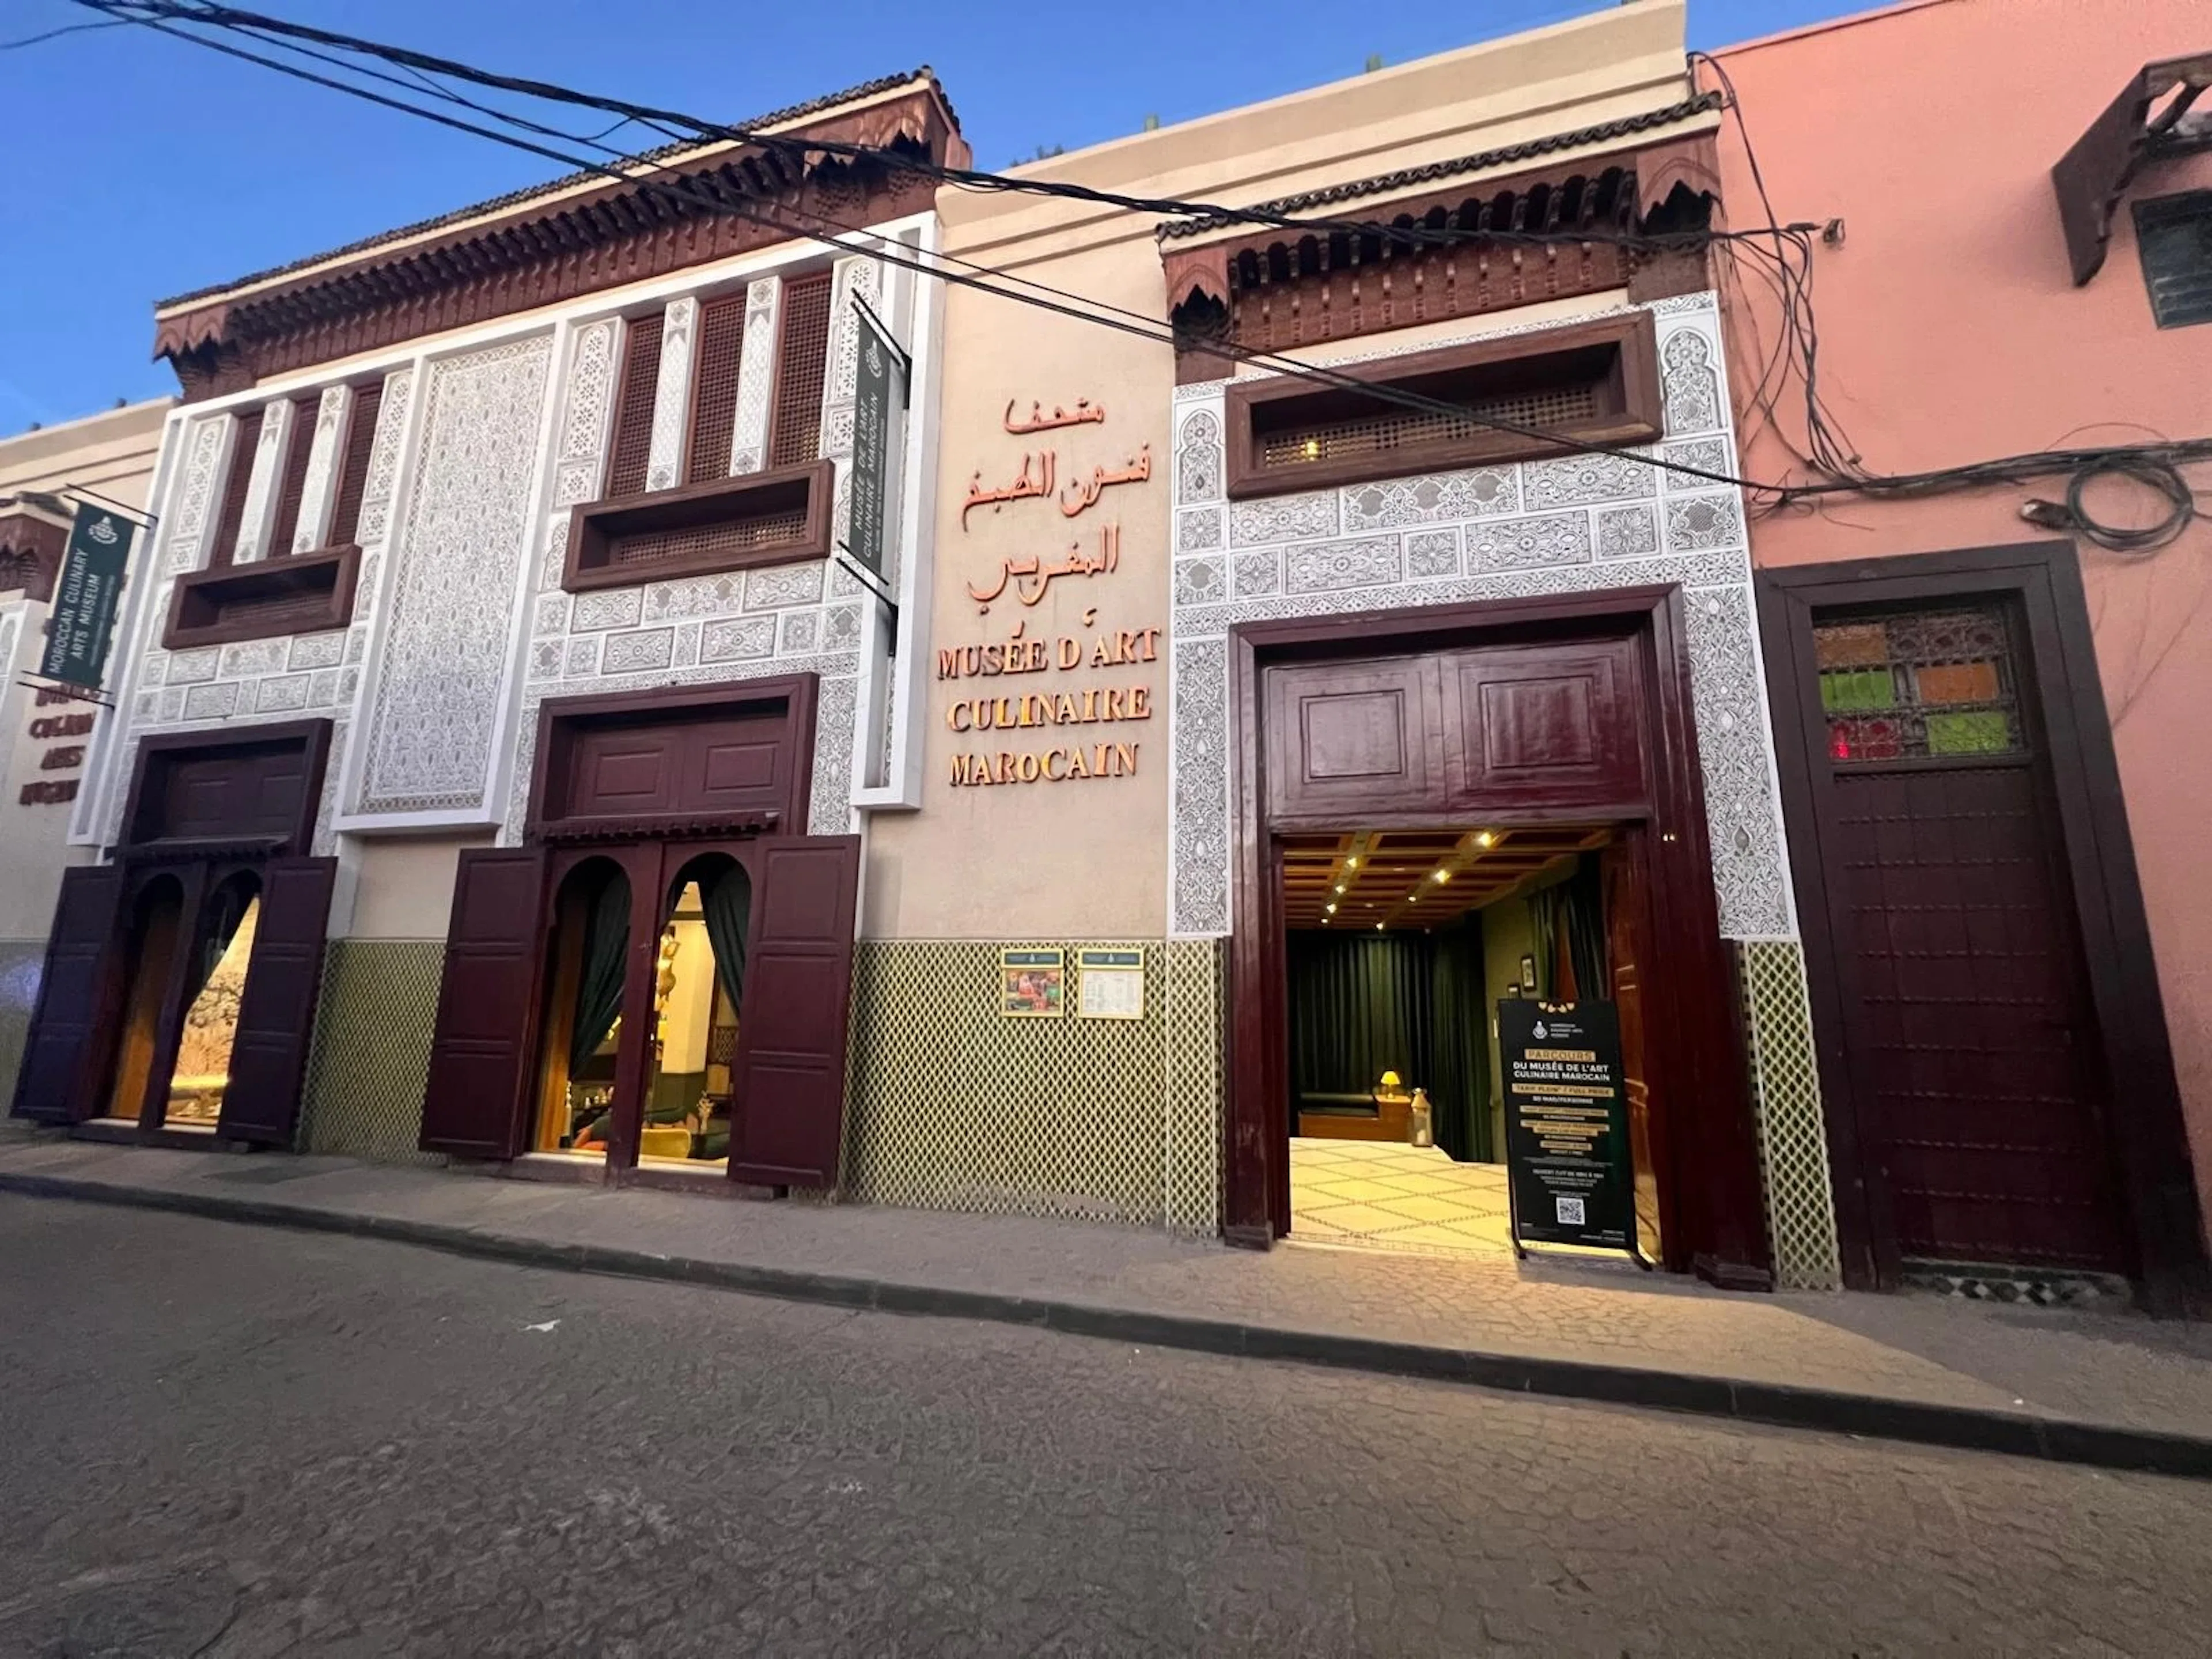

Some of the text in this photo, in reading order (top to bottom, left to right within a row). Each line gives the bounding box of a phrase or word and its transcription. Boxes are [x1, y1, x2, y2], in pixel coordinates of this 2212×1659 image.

[1004, 397, 1104, 435] متحف
[858, 444, 866, 468] DE
[864, 392, 877, 558] CULINAIRE MAROCAIN
[1060, 440, 1150, 518] فنون
[961, 448, 1055, 533] الطبخ
[967, 522, 1120, 615] المغربي
[48, 607, 75, 674] MOROCCAN
[65, 548, 88, 604] CULINARY
[70, 574, 100, 660] ARTS MUSEUM
[937, 620, 1048, 680] MUSÉE
[947, 685, 1152, 733] CULINAIRE
[949, 741, 1139, 787] MAROCAIN
[1513, 1061, 1609, 1073] DU MUSÉE DE L'ART
[1513, 1070, 1611, 1081] CULINAIRE MAROCAIN
[1528, 1050, 1592, 1060] PARCOURS
